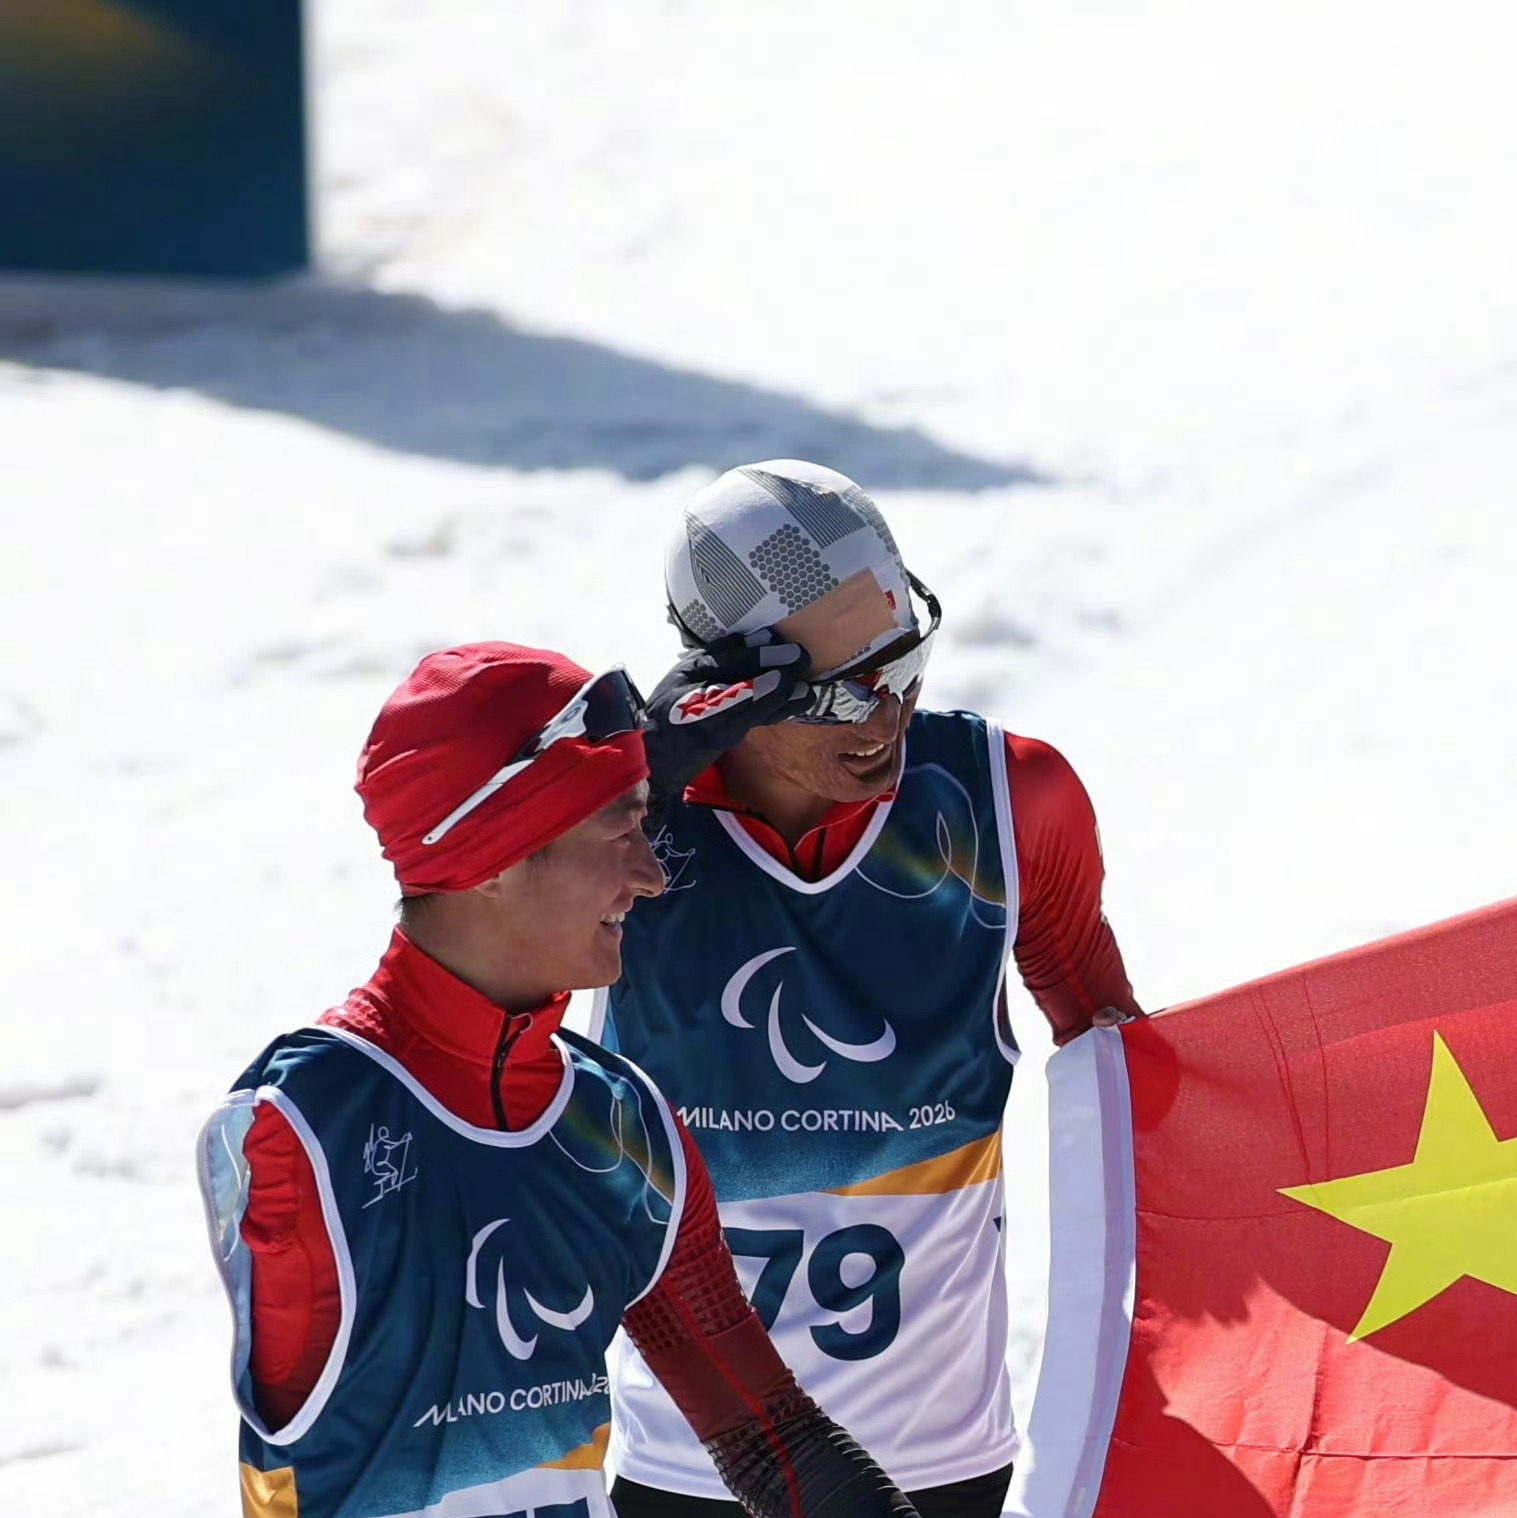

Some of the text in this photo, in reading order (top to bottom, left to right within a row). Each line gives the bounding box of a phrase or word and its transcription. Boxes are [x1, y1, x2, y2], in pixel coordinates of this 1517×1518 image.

[677, 1100, 956, 1132] MILANO CORTINA 2026
[722, 1223, 906, 1362] 79
[412, 1391, 505, 1428] MLANO
[510, 1379, 591, 1412] CORTINA
